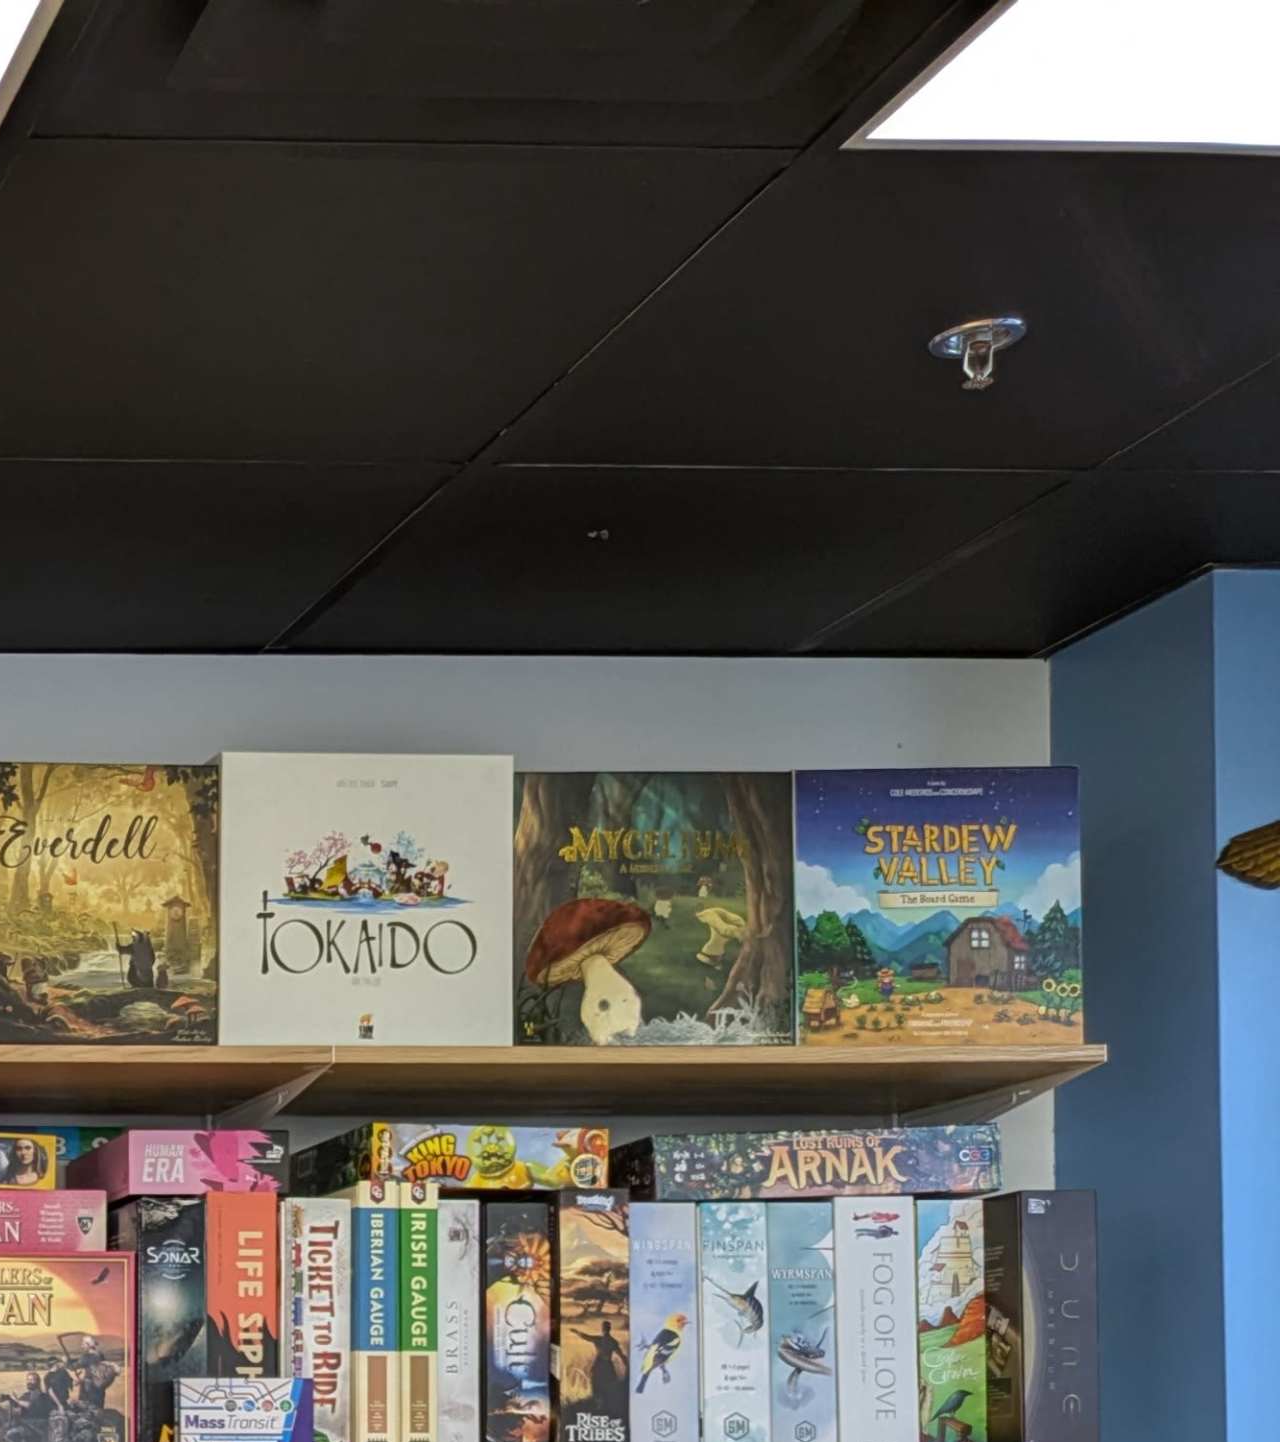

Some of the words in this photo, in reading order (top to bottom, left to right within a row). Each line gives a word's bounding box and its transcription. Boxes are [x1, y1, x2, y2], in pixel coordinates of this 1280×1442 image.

[863, 822, 1018, 855] STARDEW
[875, 854, 1002, 887] VALLEY
[900, 894, 917, 905] The
[919, 894, 945, 906] Board
[948, 894, 975, 906] Game
[256, 890, 478, 975] TOKAIDO
[405, 1134, 457, 1162] KING
[792, 1137, 821, 1149] LOST
[142, 1158, 186, 1184] ERA
[403, 1154, 472, 1183] TOKYO
[762, 1145, 908, 1190] ARNAK
[146, 1248, 202, 1265] SONAR
[370, 1213, 385, 1282] IBERIAN
[410, 1213, 428, 1269] IRISH
[702, 1240, 765, 1254] FINSPAN
[237, 1230, 264, 1299] LIFE
[306, 1220, 341, 1318] TICKET
[871, 1251, 894, 1306] FOG
[369, 1287, 385, 1347] GAUGE
[410, 1275, 428, 1347] GAUGE
[313, 1323, 332, 1346] TO
[446, 1301, 458, 1374] BRASS
[873, 1313, 895, 1348] OF
[312, 1350, 342, 1413] RIDE
[874, 1357, 897, 1420] LOVE
[184, 1415, 225, 1429] Mass
[226, 1415, 278, 1431] Transit
[565, 1424, 626, 1442] TRIBES
[576, 1412, 609, 1428] RISE
